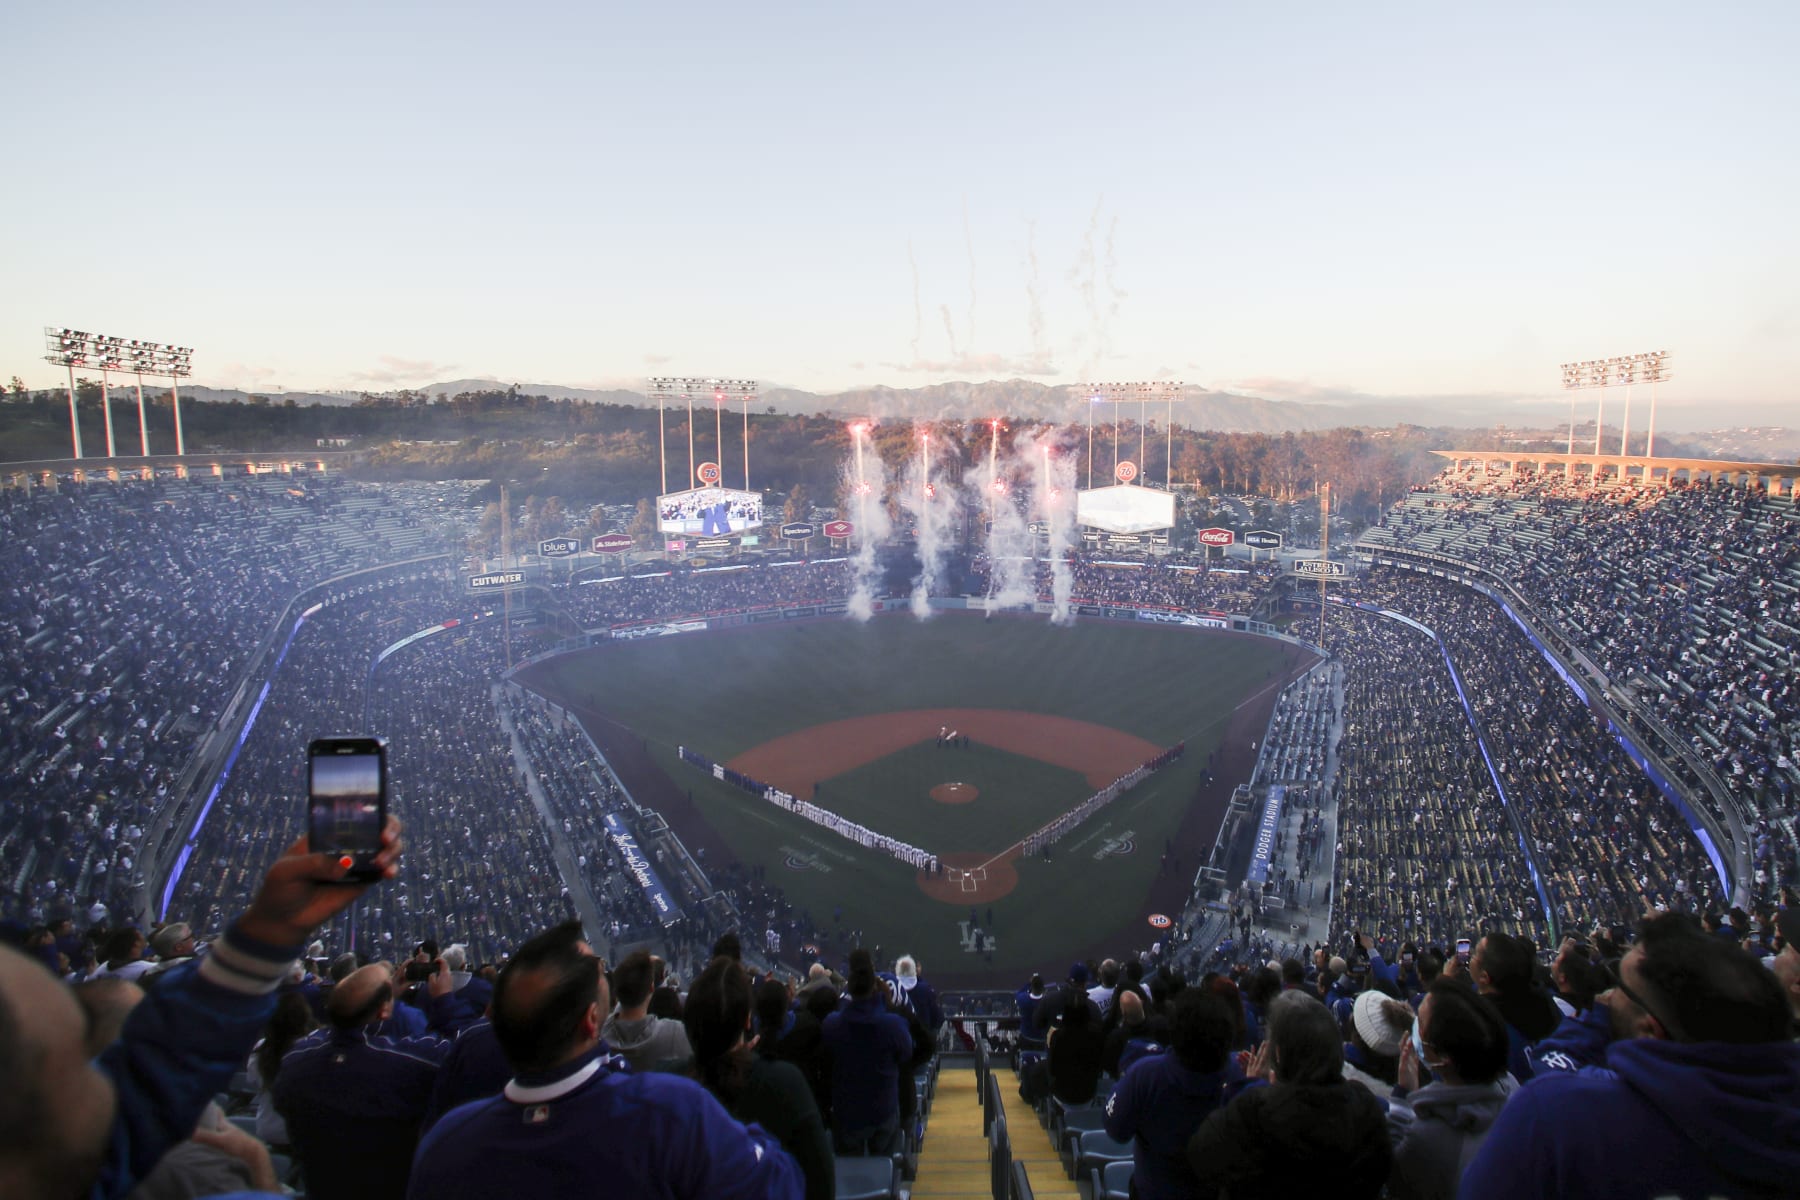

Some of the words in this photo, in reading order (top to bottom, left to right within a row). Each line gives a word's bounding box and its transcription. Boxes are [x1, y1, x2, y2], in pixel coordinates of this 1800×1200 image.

[705, 468, 717, 478] 76
[1121, 468, 1133, 476] 76
[543, 542, 567, 552] blue
[472, 573, 522, 587] CUTWATER
[1263, 799, 1279, 827] STADIUM
[1255, 829, 1272, 859] DODGER
